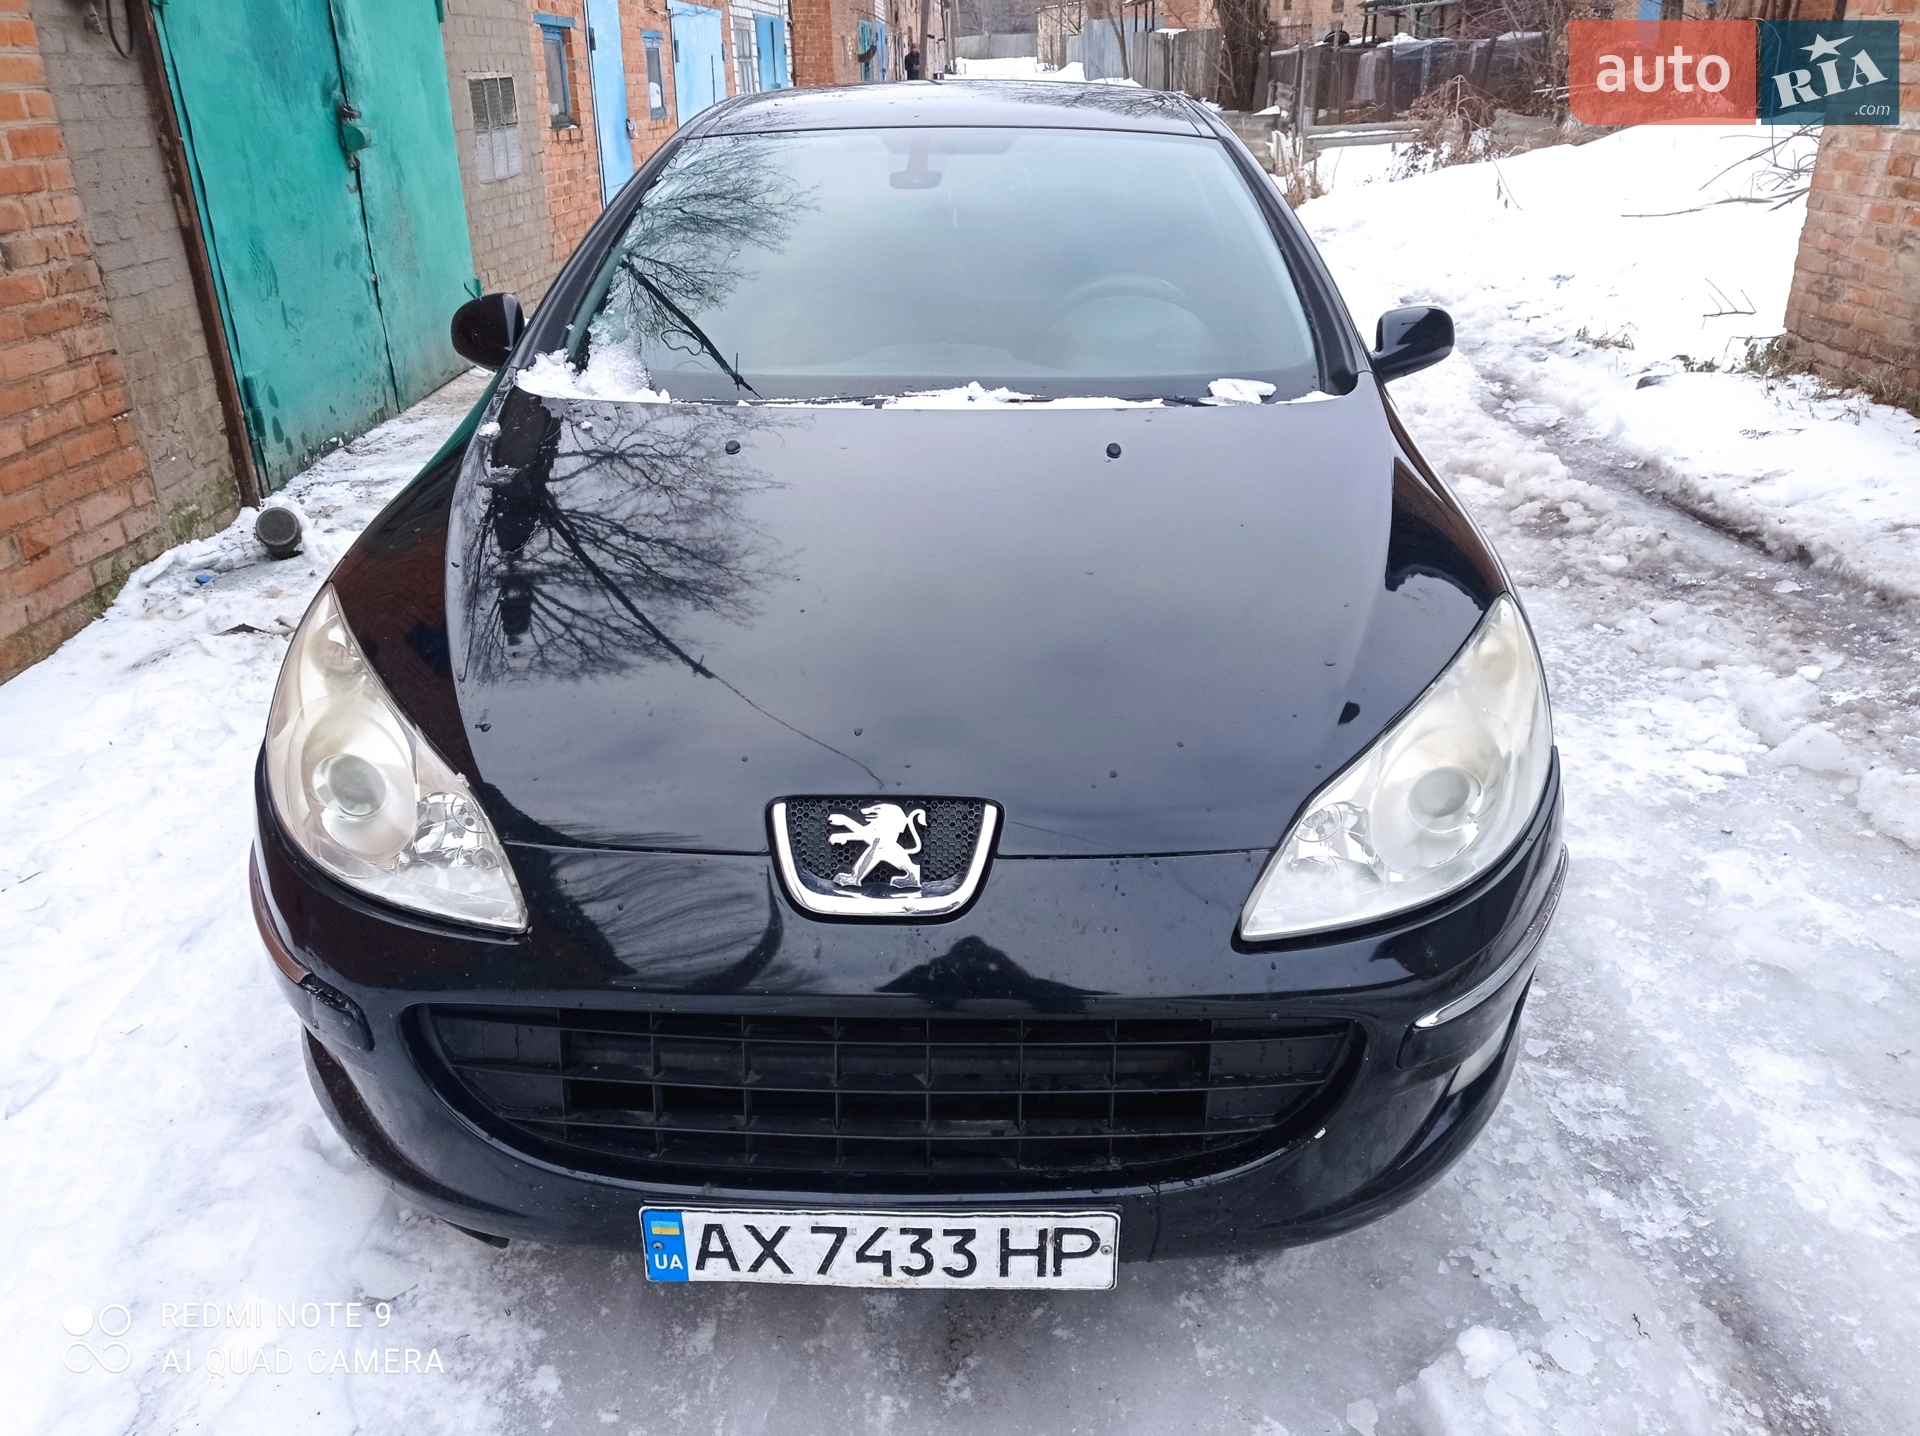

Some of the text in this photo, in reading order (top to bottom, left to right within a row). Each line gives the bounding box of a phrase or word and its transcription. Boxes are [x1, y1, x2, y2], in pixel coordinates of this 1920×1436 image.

[654, 1253, 684, 1271] UA
[695, 1223, 1101, 1279] AX 7433 HP
